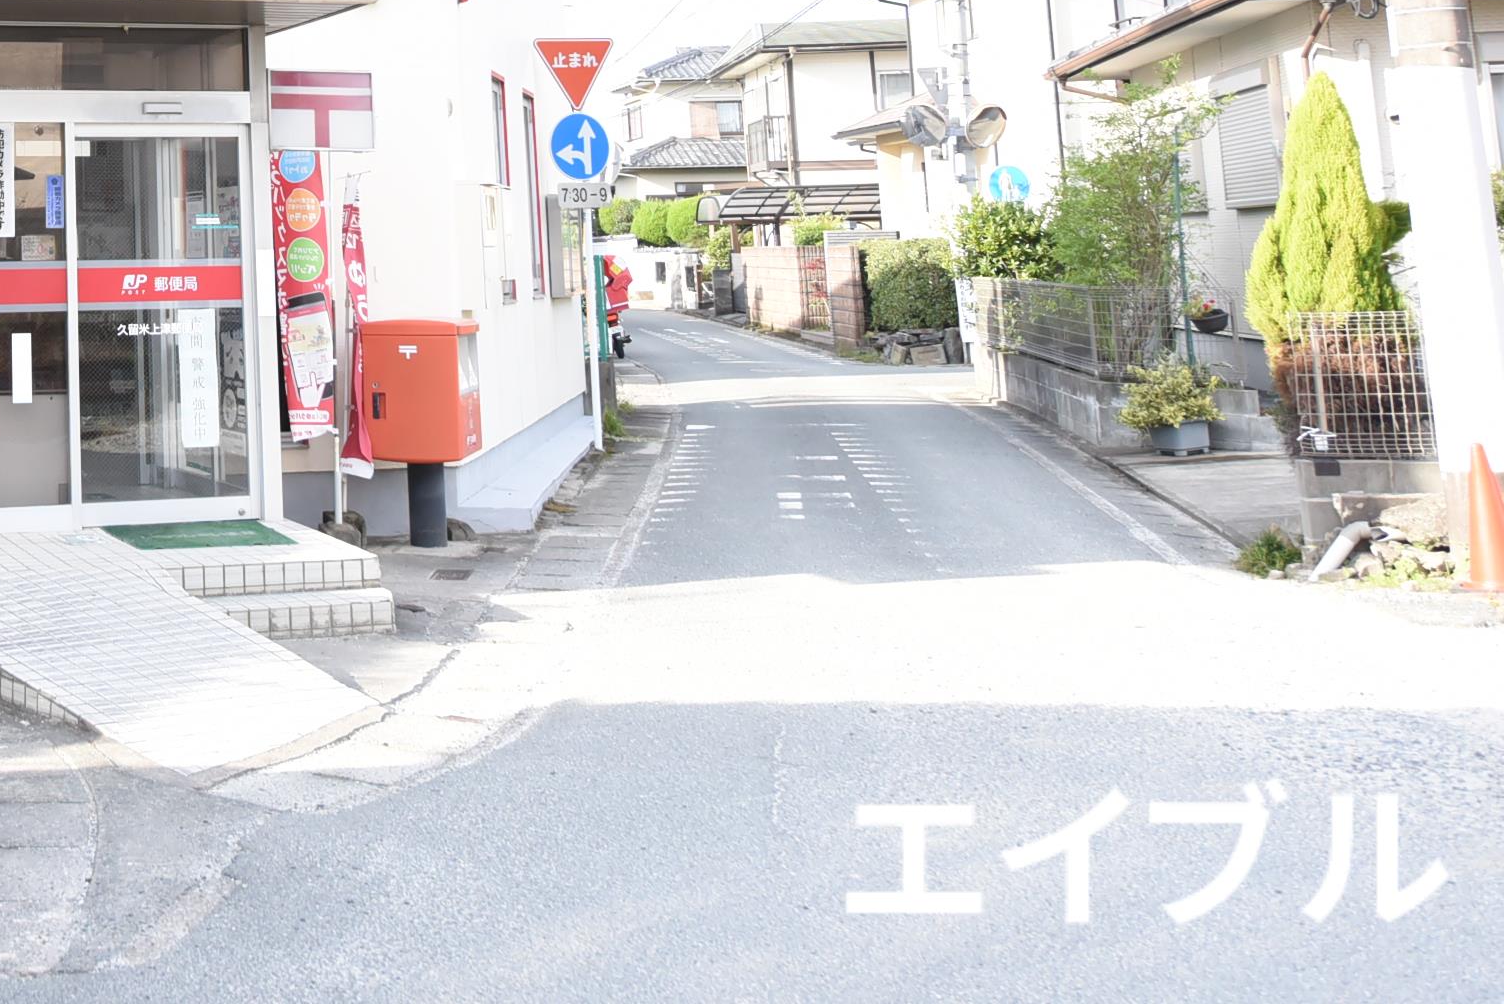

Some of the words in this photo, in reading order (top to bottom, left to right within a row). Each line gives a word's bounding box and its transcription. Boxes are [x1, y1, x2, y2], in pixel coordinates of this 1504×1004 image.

[552, 52, 599, 68] 止まれ
[154, 276, 198, 292] 郵便局
